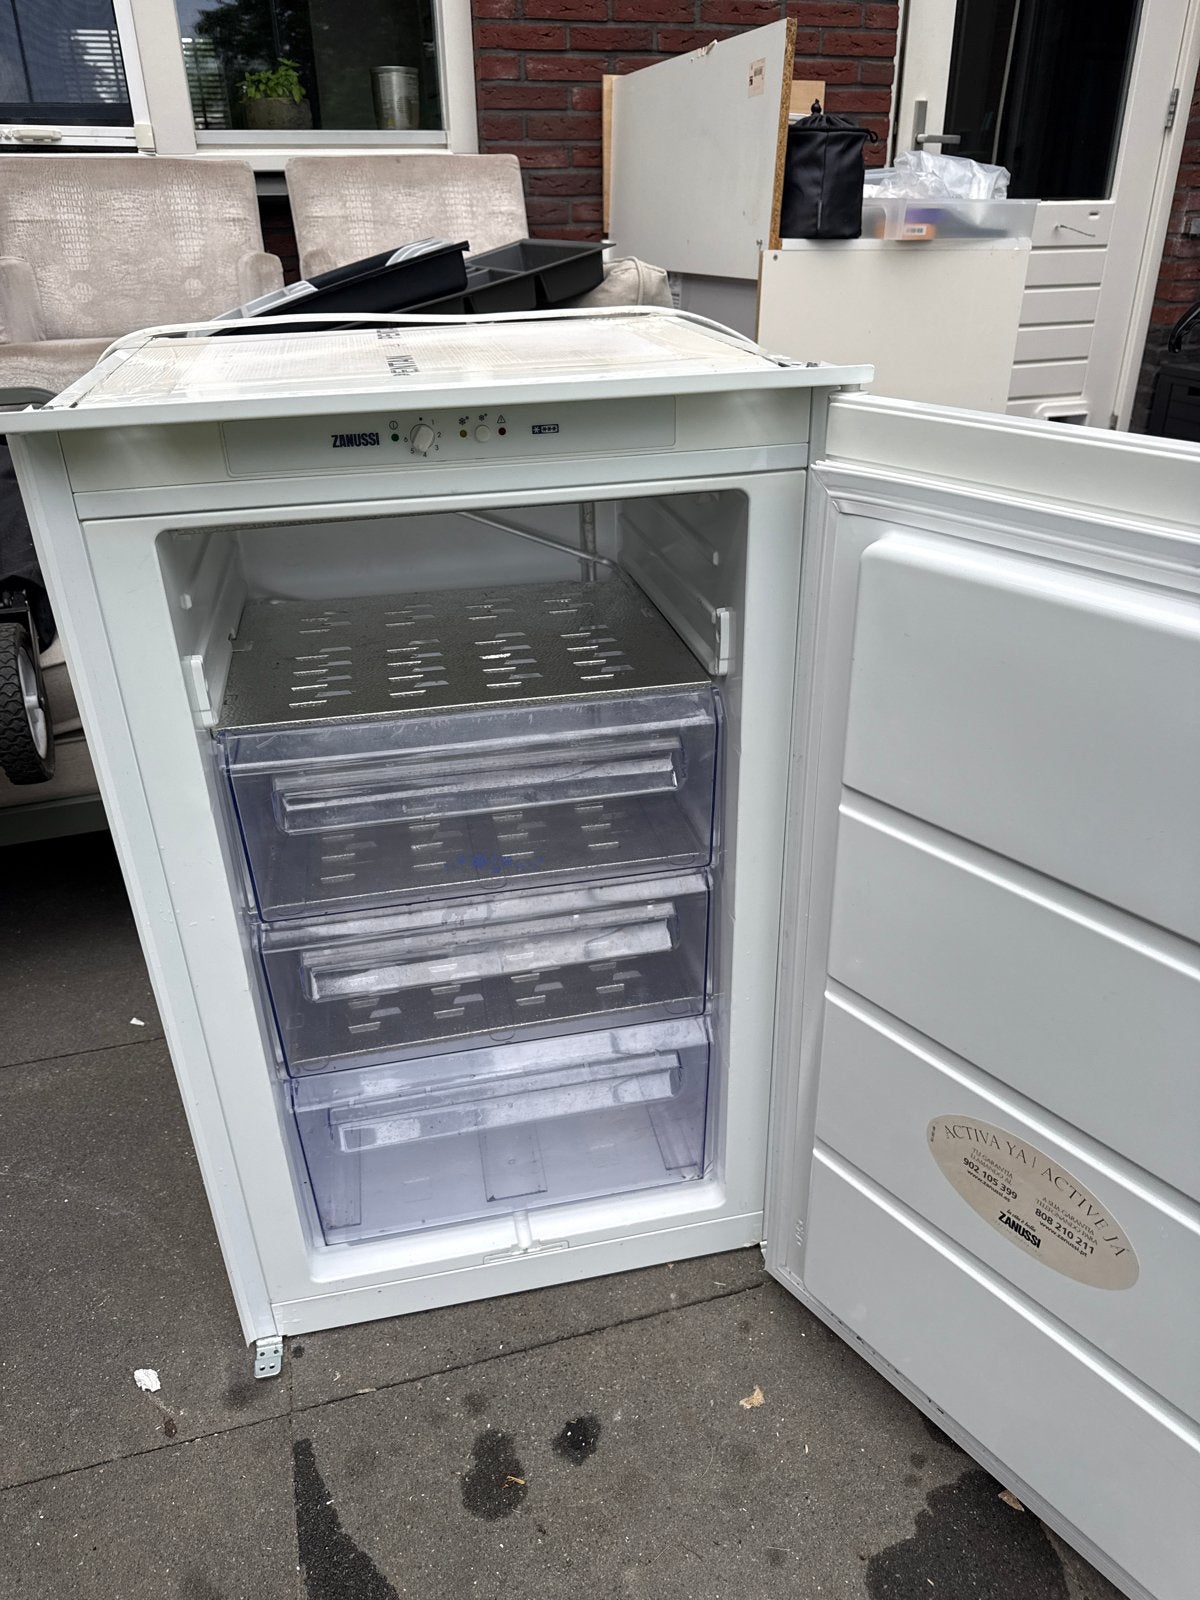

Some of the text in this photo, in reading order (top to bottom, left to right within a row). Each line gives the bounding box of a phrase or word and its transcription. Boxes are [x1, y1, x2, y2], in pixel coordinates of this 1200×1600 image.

[331, 432, 380, 448] ZANUSSI
[943, 1124, 1001, 1150] ACTIVA
[1006, 1141, 1027, 1165] YA
[1041, 1167, 1109, 1230] ACTIVE
[963, 1157, 1018, 1200] 902 105 399
[967, 1170, 1011, 1203] www.zanussi.es
[998, 1210, 1042, 1249] ZANUSSI
[1035, 1208, 1054, 1226] 808
[1054, 1222, 1074, 1240] 210
[1075, 1236, 1095, 1254] 211
[1039, 1221, 1088, 1257] www.zanussi.pt
